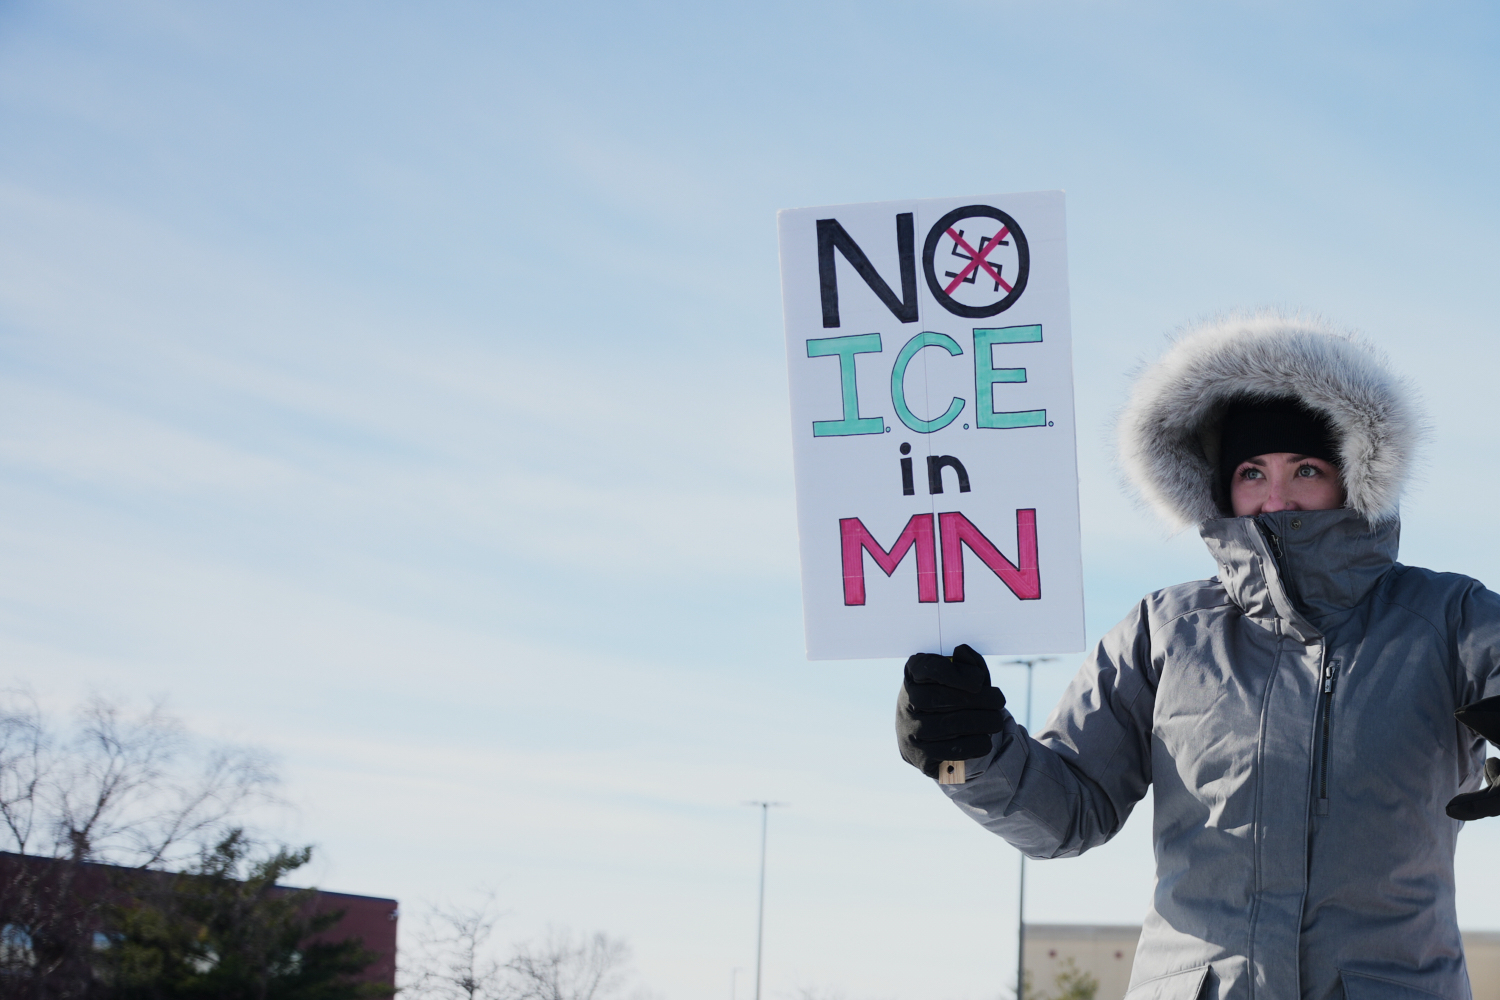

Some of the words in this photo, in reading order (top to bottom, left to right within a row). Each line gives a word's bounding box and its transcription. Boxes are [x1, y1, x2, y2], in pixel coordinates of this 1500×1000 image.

[815, 204, 1030, 328] NO
[806, 324, 1054, 437] I.C.E.
[899, 442, 971, 496] in
[839, 508, 1041, 606] MN
